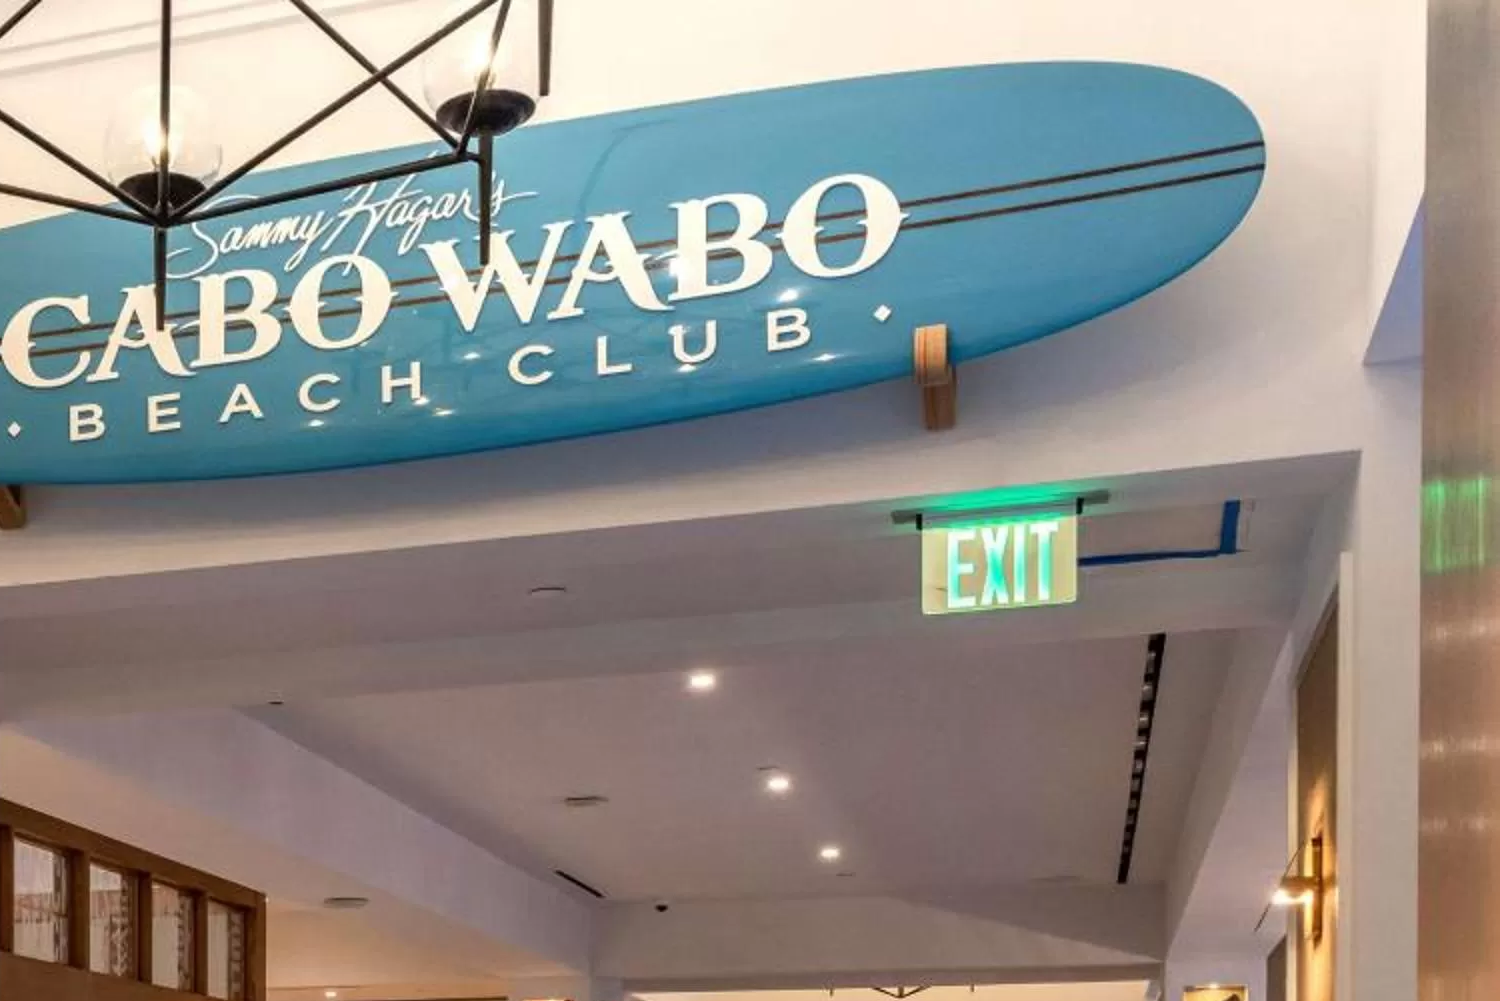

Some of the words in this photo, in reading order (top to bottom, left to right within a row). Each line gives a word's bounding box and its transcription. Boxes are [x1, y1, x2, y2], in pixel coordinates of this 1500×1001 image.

[166, 194, 333, 279] Sammy
[418, 173, 910, 333] WABO
[69, 361, 424, 443] BEACH
[507, 308, 812, 386] CLUB
[947, 521, 1059, 609] EXIT
